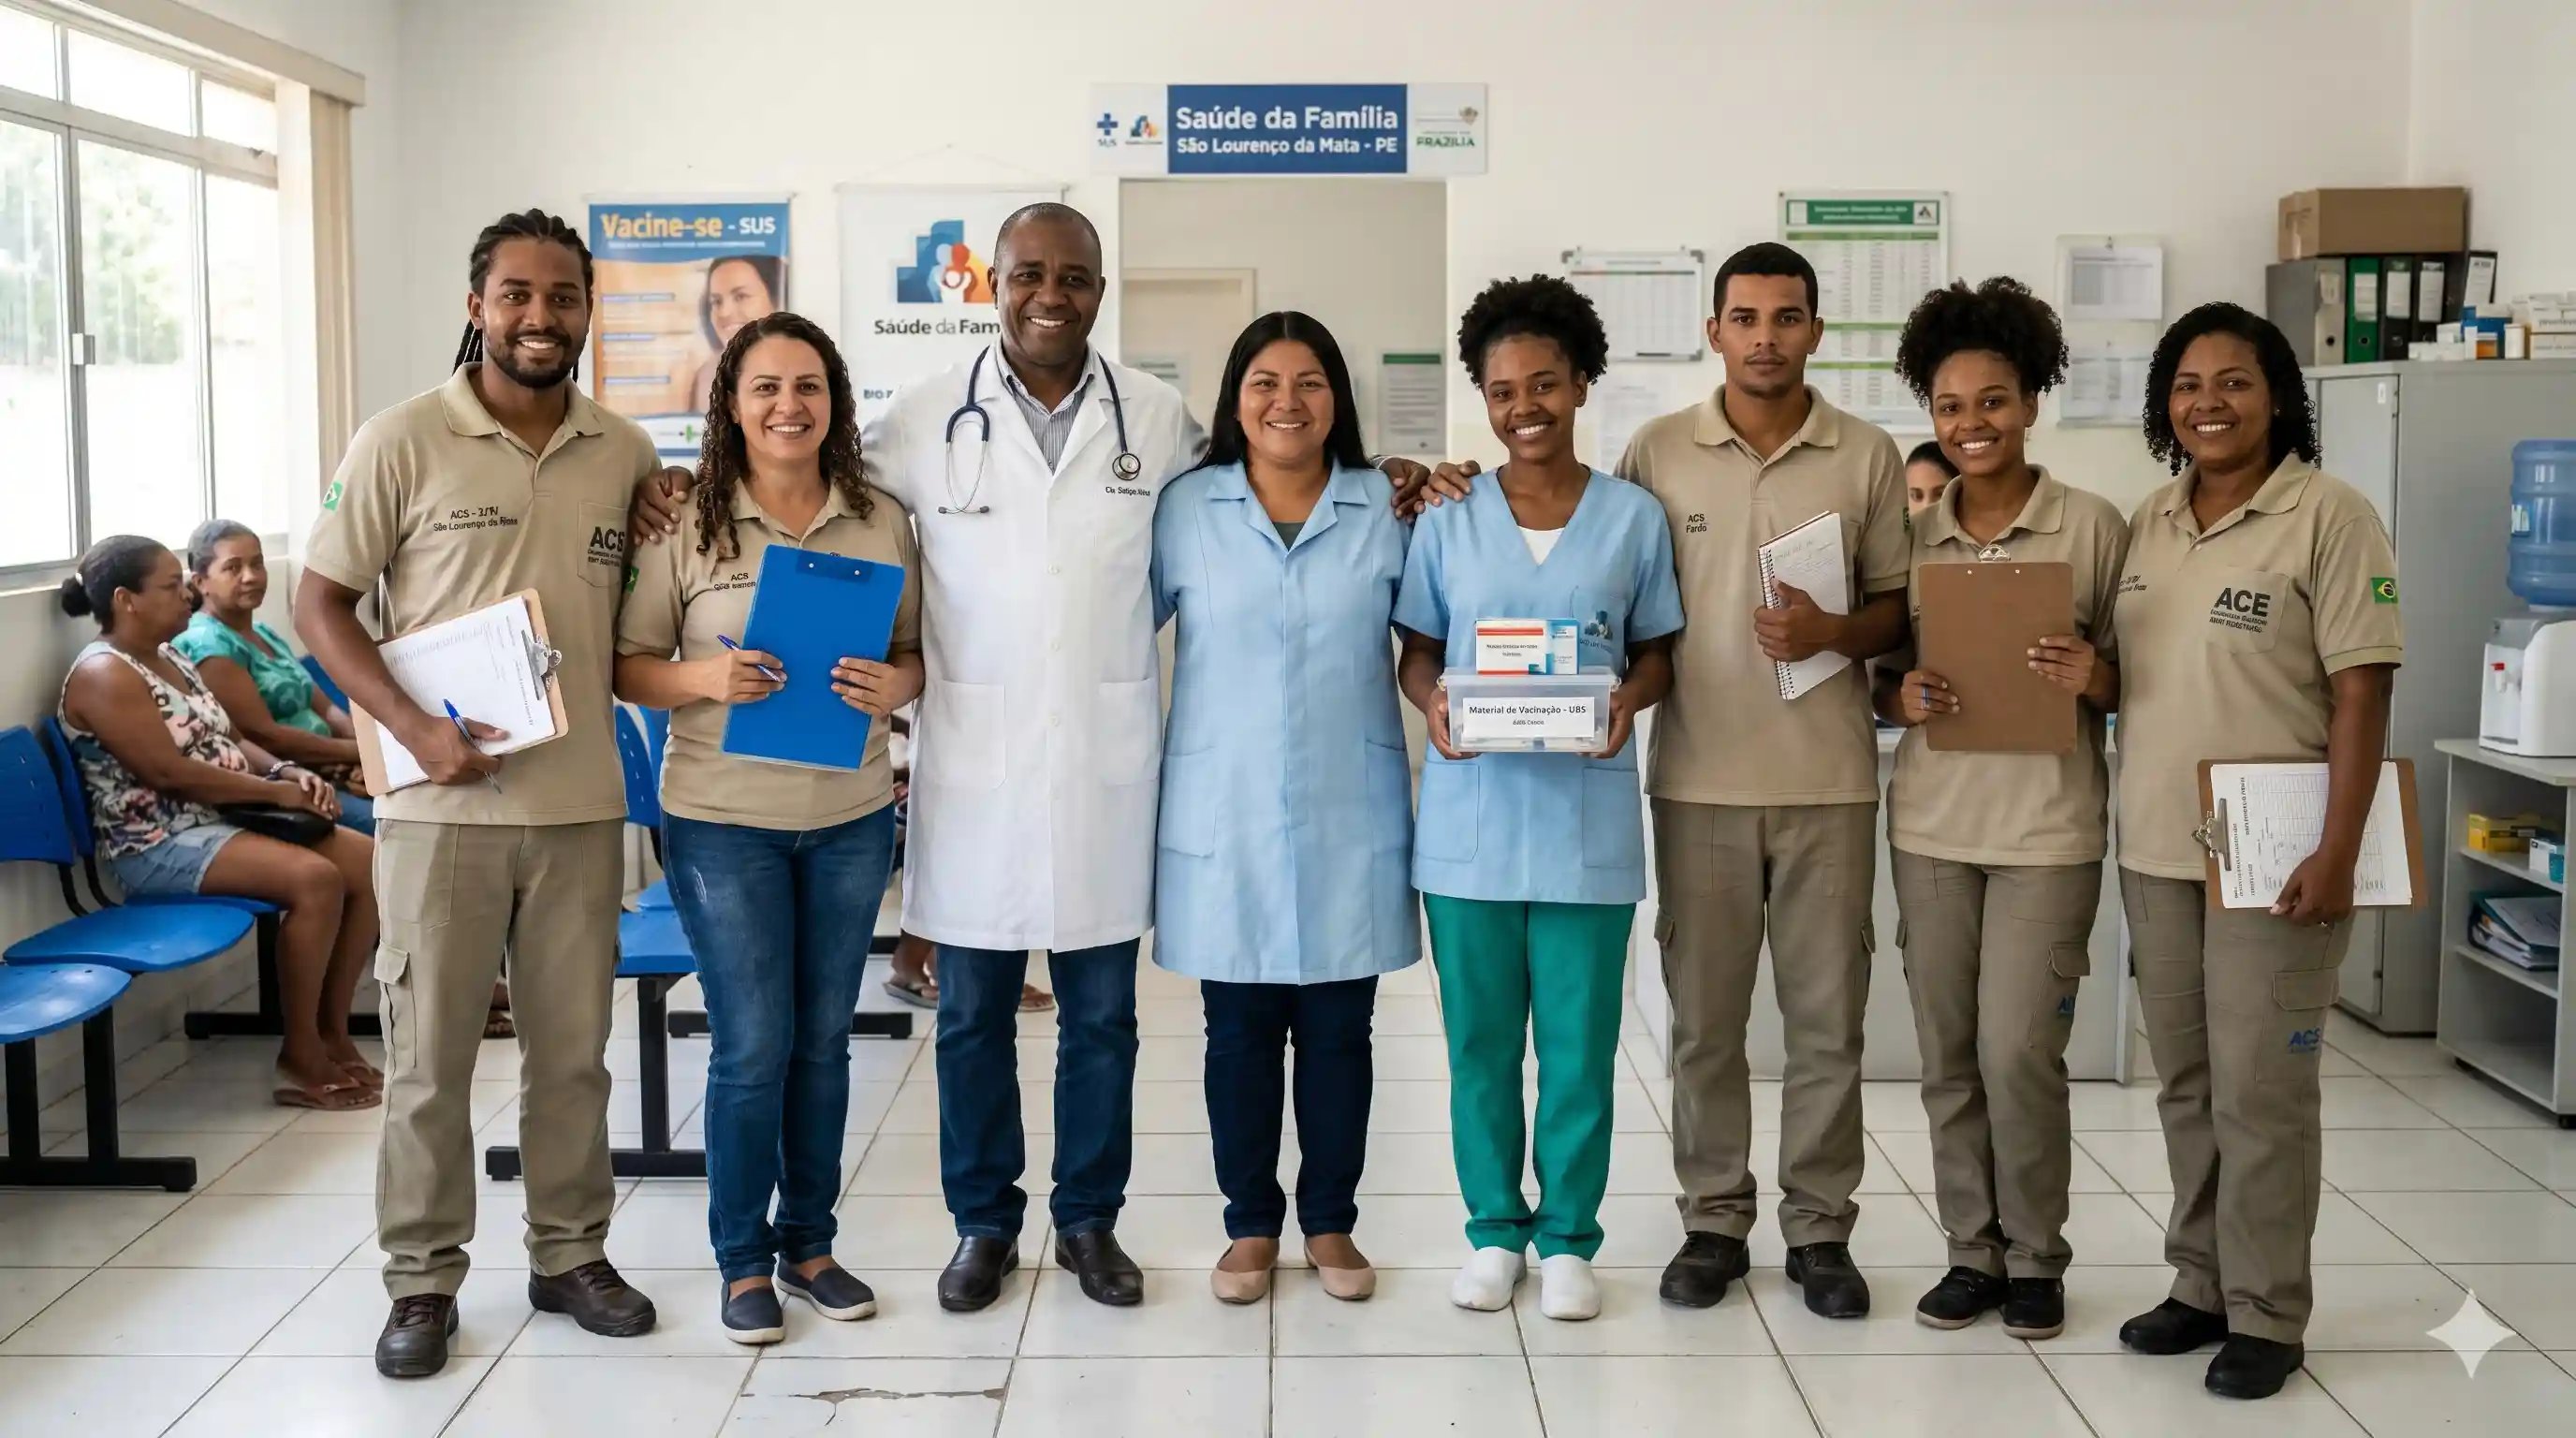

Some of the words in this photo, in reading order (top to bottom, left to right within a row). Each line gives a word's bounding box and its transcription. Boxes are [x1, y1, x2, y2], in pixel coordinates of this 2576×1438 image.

[1176, 105, 1257, 129] Saúde
[1265, 105, 1297, 129] da
[1305, 105, 1398, 129] Família
[1178, 137, 1208, 154] São
[1212, 137, 1290, 157] Lourenço
[1294, 137, 1315, 154] da
[1319, 137, 1360, 154] Mata
[1375, 137, 1398, 154] PE
[599, 212, 724, 240] Vacine-se
[739, 216, 777, 235] SUS
[873, 318, 932, 335] Saúde
[935, 317, 957, 335] da
[959, 319, 1002, 334] Fam
[450, 508, 470, 520] ACS
[1687, 513, 1705, 523] ACS
[730, 572, 749, 581] ACS
[2214, 587, 2271, 618] ACE
[1469, 705, 1504, 714] Material
[1506, 705, 1517, 714] de
